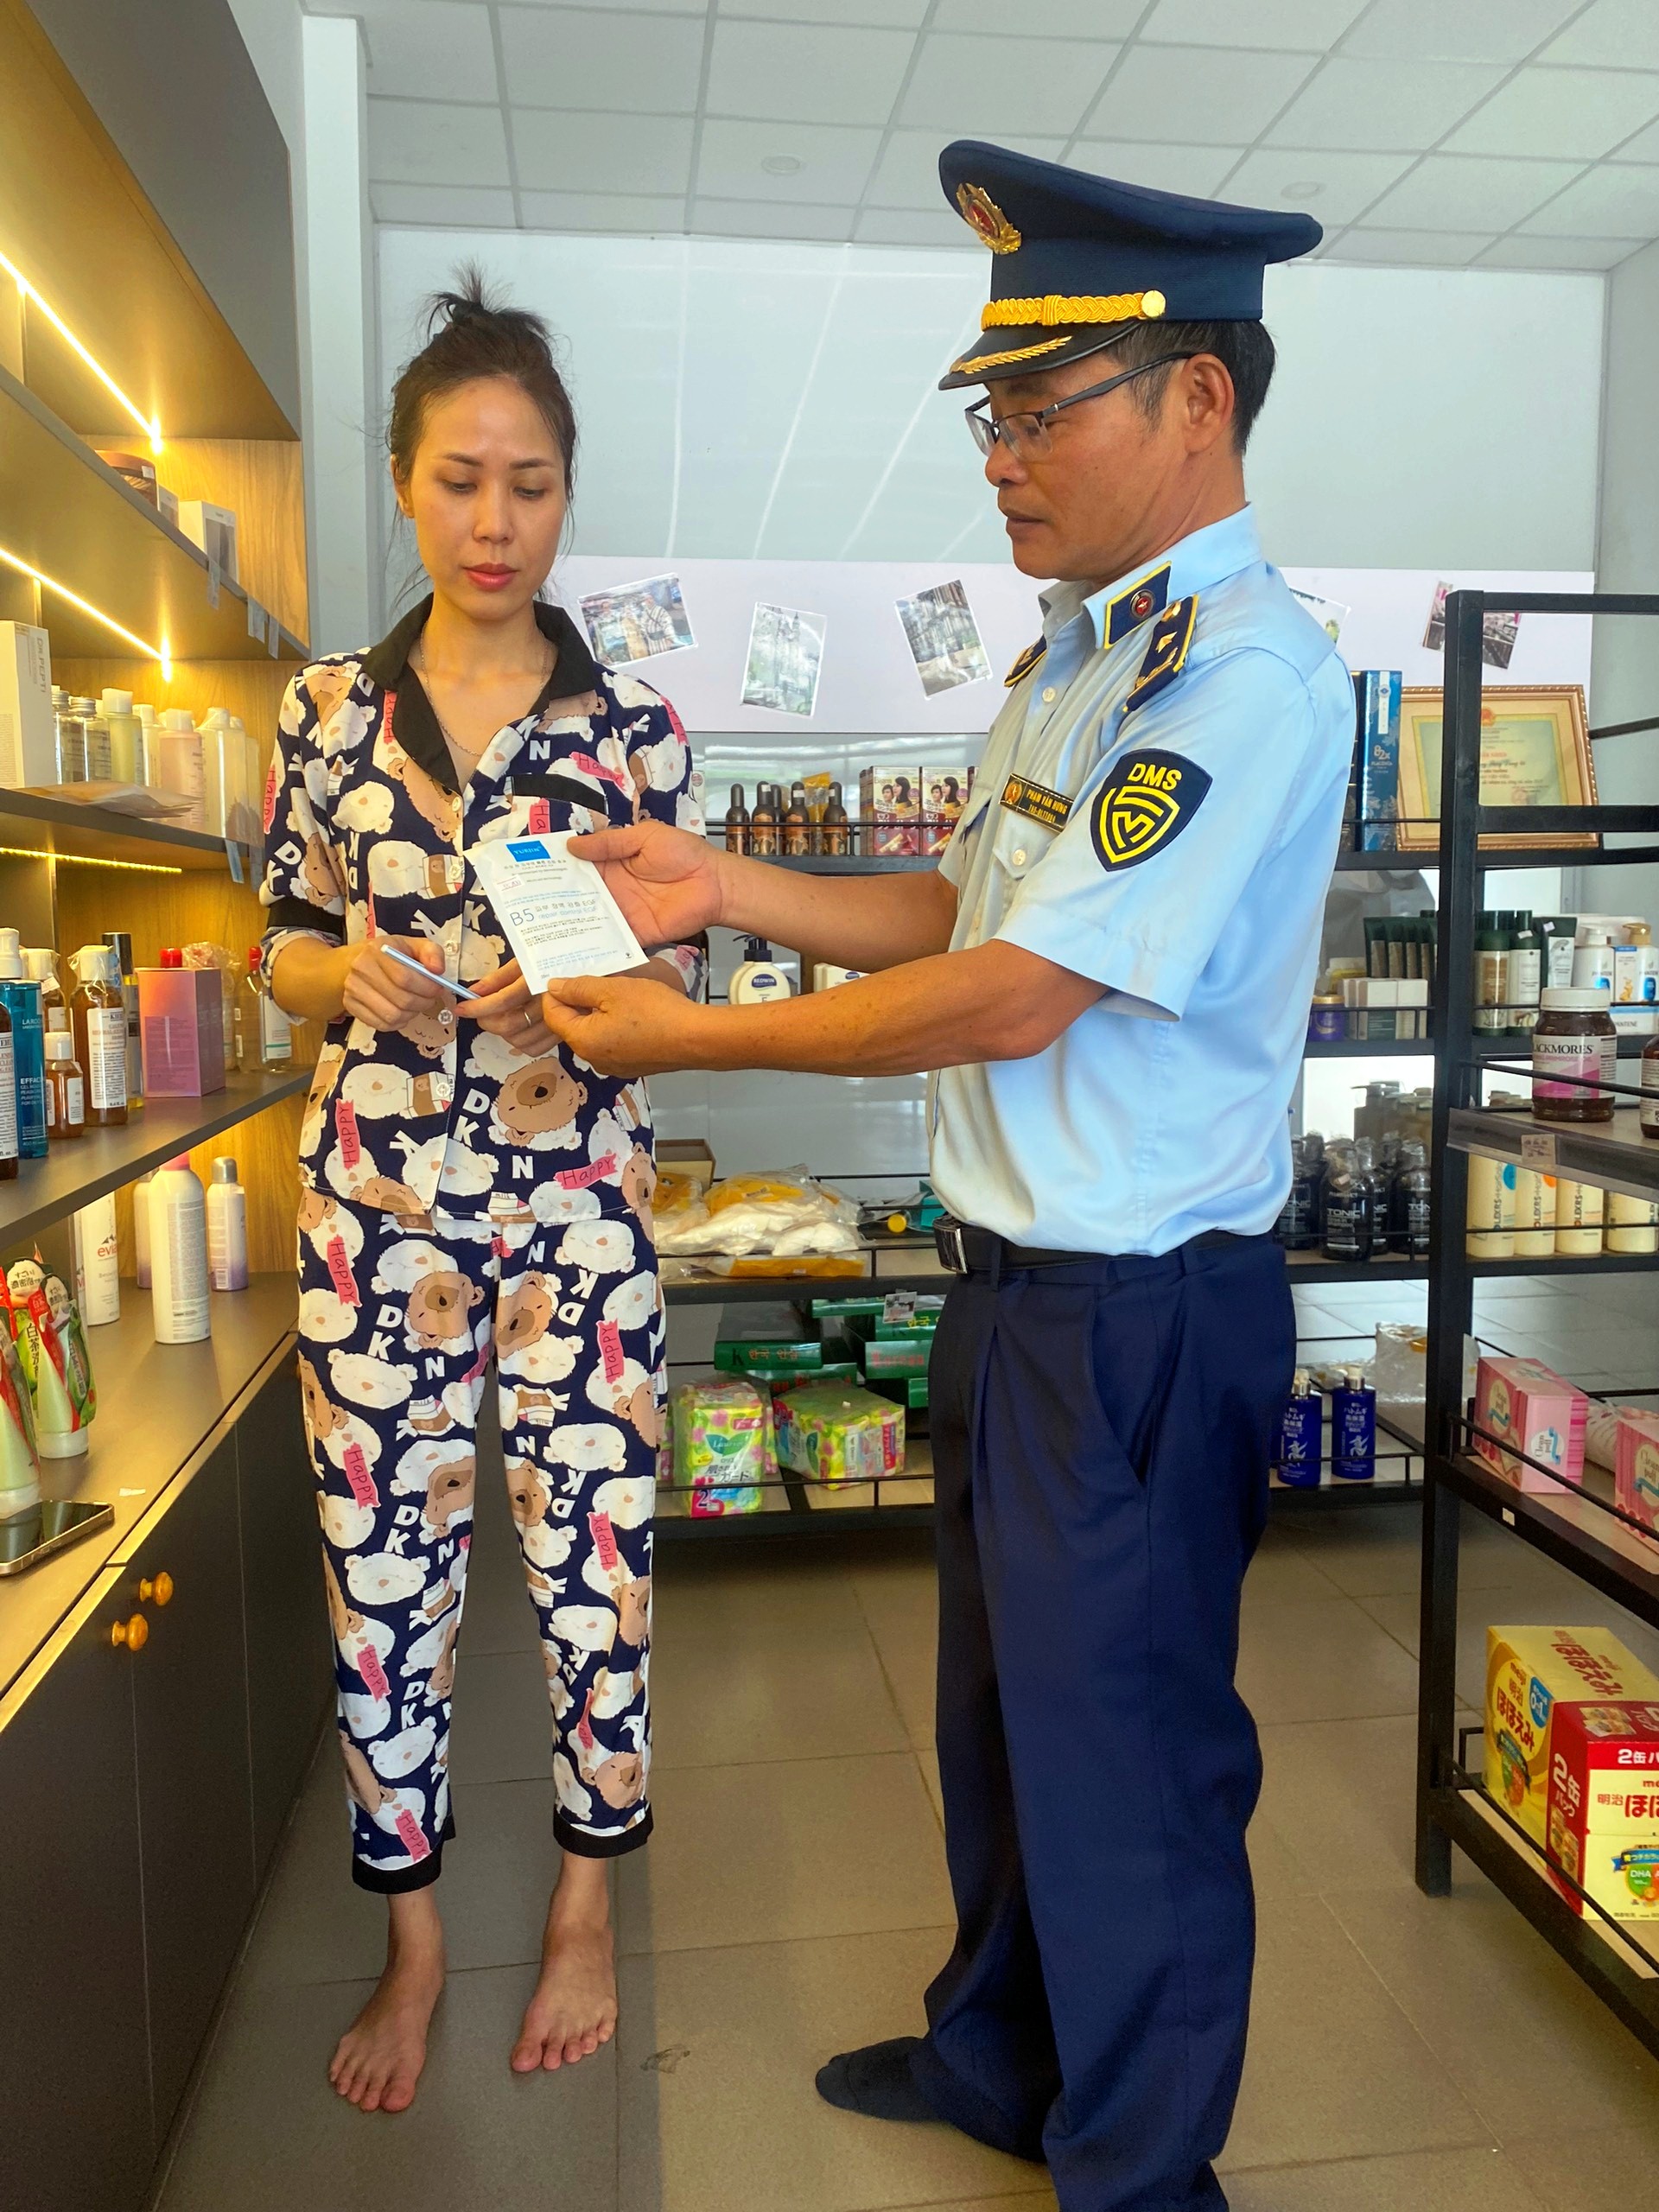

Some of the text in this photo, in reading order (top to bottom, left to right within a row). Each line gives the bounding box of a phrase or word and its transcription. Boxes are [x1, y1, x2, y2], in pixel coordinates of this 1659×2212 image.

[529, 740, 551, 761] N
[1127, 762, 1182, 791] DMS
[274, 841, 302, 865] D
[510, 907, 535, 927] B5
[462, 1088, 491, 1115] D
[338, 1105, 357, 1164] Happy
[453, 1115, 480, 1149] K
[512, 1154, 534, 1180] N
[562, 1158, 611, 1186] Happy
[1326, 1207, 1361, 1217] TONIC
[526, 1240, 546, 1265] N
[332, 1242, 356, 1300] Happy
[569, 1268, 600, 1300] K
[376, 1303, 404, 1328] D
[557, 1301, 586, 1326] D
[366, 1331, 396, 1362] K
[602, 1326, 621, 1379] Happy
[424, 1356, 446, 1381] N
[515, 1434, 536, 1457] N
[1534, 1435, 1545, 1458] Clean
[347, 1449, 373, 1502] Happy
[560, 1469, 588, 1496] K
[393, 1504, 420, 1527] D
[551, 1497, 576, 1519] D
[383, 1528, 412, 1555] K
[437, 1539, 454, 1566] N
[593, 1516, 615, 1567] Happy
[360, 1649, 386, 1694] Happy
[403, 1680, 426, 1701] D
[400, 1702, 417, 1731] K
[1497, 1686, 1535, 1753] ほほえみ
[1597, 1793, 1624, 1806] 明治
[401, 1815, 428, 1857] Happy
